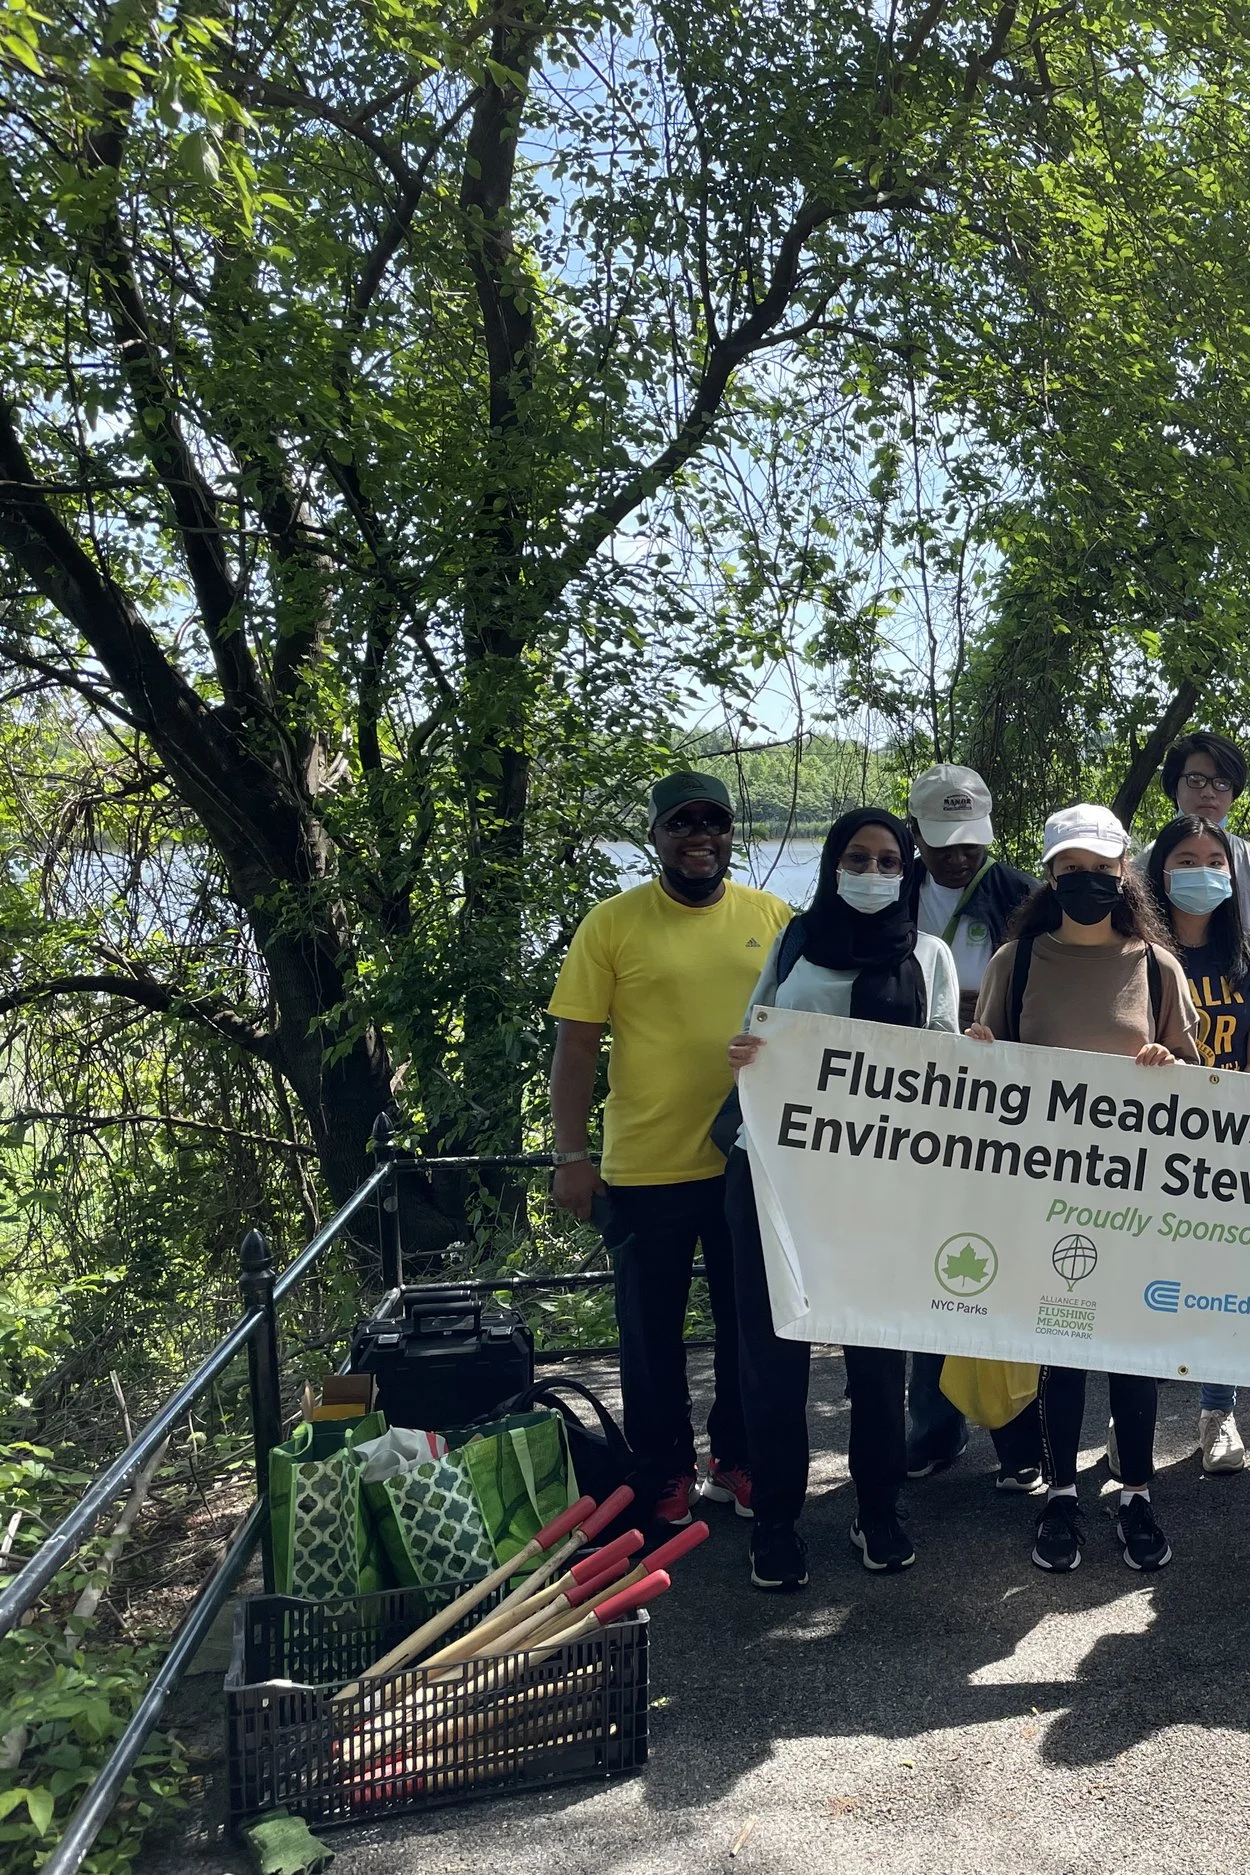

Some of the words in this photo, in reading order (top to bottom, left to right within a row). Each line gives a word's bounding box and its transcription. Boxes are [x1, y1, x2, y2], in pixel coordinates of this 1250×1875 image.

[818, 1048, 1031, 1125] Flushing
[777, 1103, 1148, 1192] Environmental
[1046, 1199, 1152, 1238] Proudly
[931, 1299, 955, 1312] NYC
[956, 1302, 988, 1315] Parks
[1040, 1295, 1079, 1306] ALLIANCE
[1081, 1300, 1097, 1308] FOR
[1038, 1306, 1096, 1321] FLUSHING
[1036, 1317, 1094, 1332] MEADOWS
[1035, 1327, 1070, 1337] CORONA
[1070, 1331, 1093, 1340] PARK
